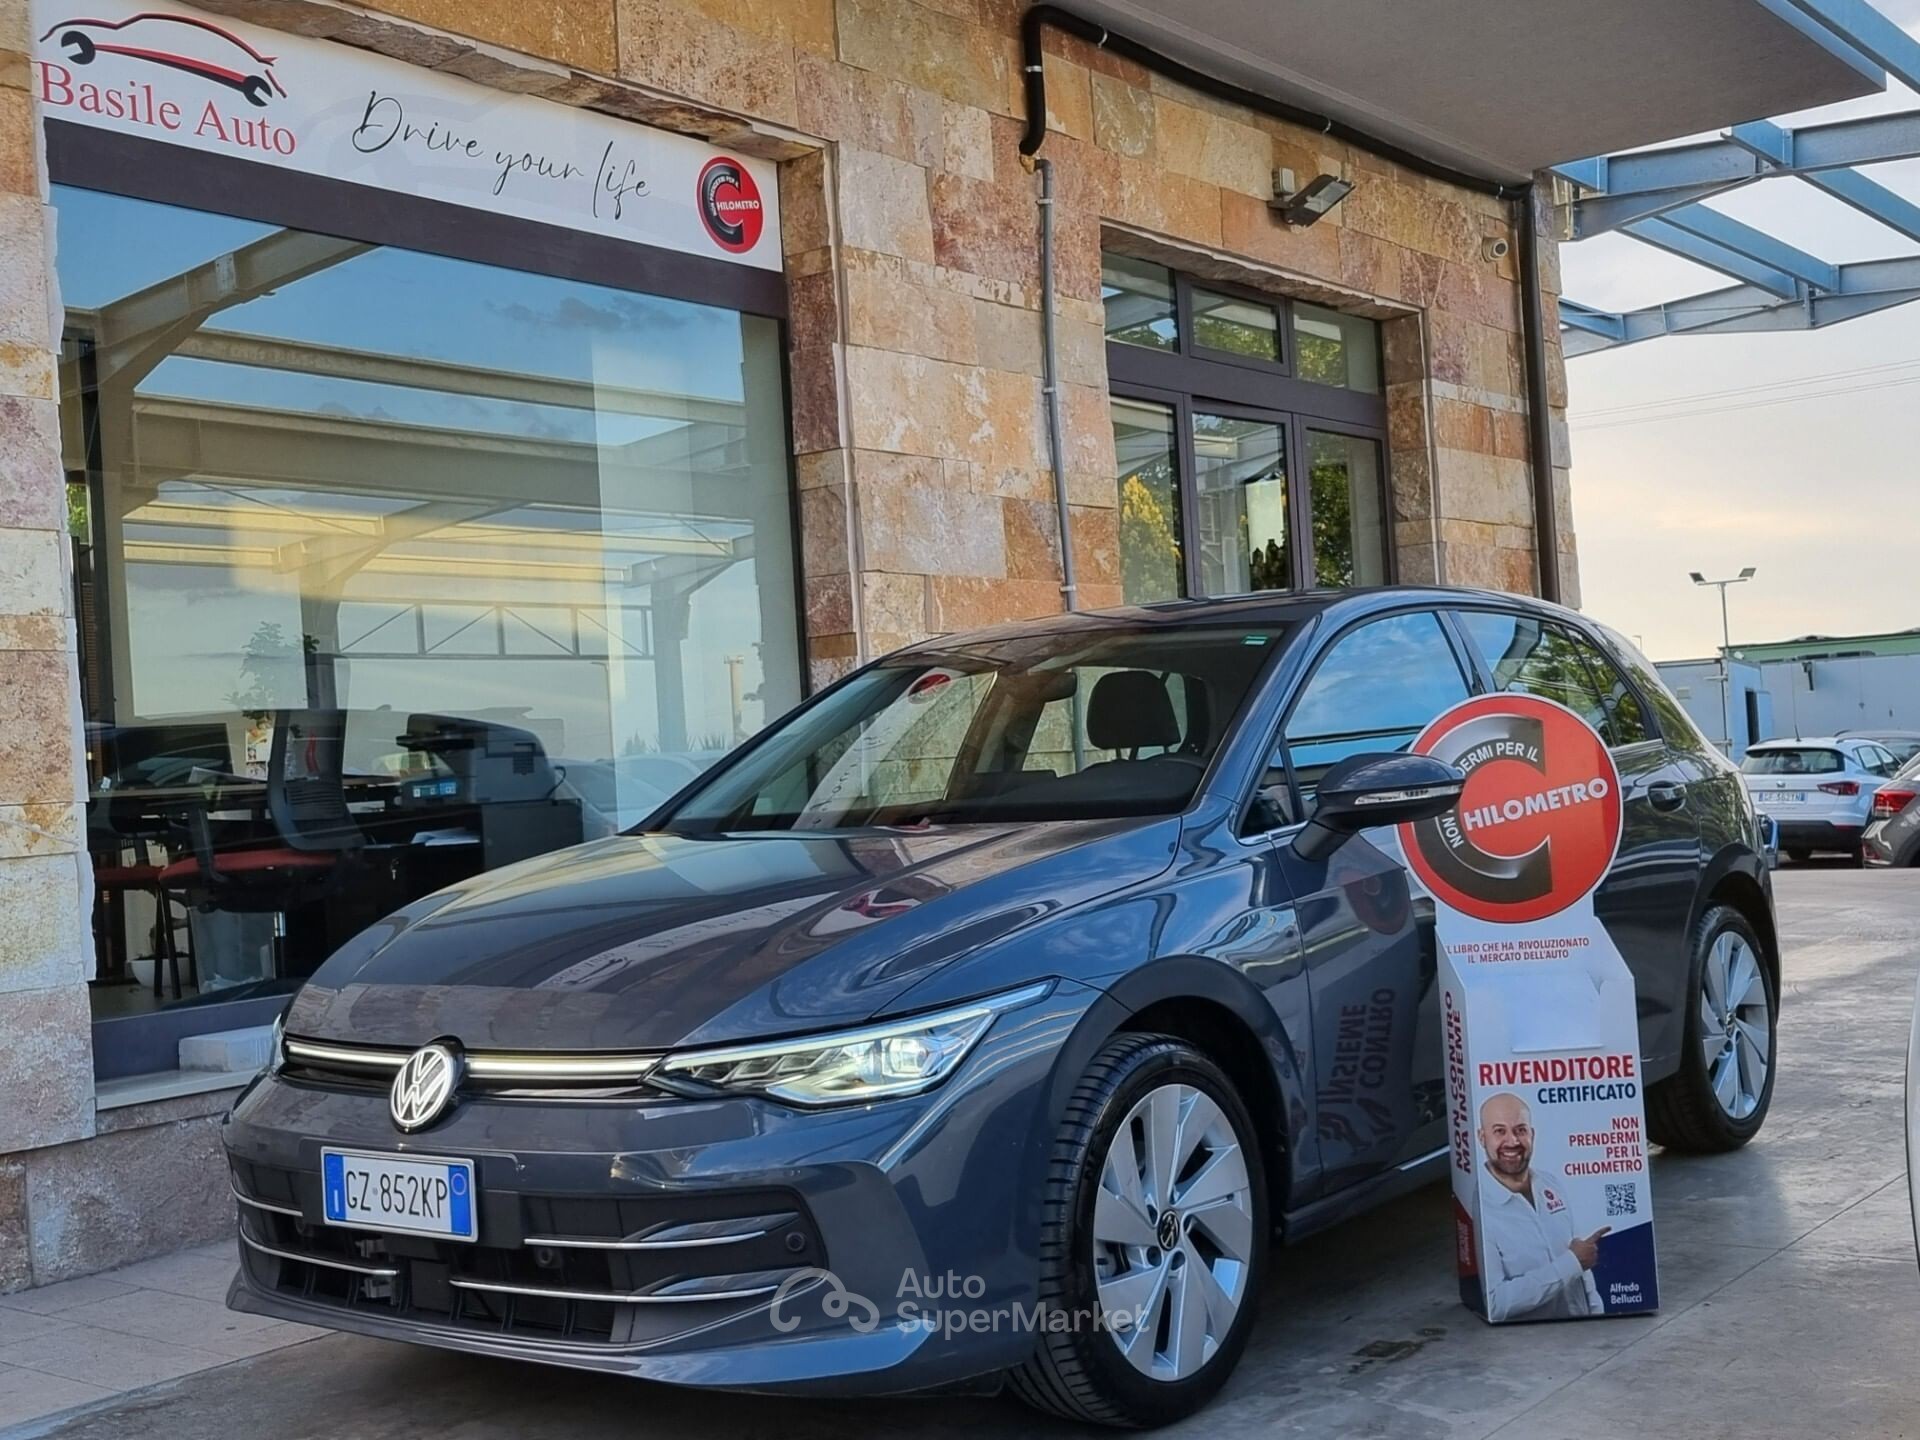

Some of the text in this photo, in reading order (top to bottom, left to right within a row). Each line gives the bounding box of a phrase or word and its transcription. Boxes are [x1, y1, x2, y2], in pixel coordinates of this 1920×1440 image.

[39, 61, 297, 155] Basile Auto
[352, 90, 651, 220] Drive your life
[1442, 816, 1465, 849] NON
[1496, 742, 1525, 757] PER
[1526, 746, 1539, 763] IL
[1453, 943, 1480, 954] LIBRO
[1482, 942, 1500, 952] CHE
[1501, 941, 1514, 951] HA
[1518, 937, 1590, 950] RIVOLUZIONATO
[1467, 949, 1569, 964] IL MERCATO DELL'AUTO
[1445, 991, 1464, 1169] NON CONTRO
[1478, 1055, 1635, 1087] RIVENDITORE
[1453, 1010, 1472, 1175] MA INSIEME
[1537, 1084, 1637, 1105] CERTIFICATO
[1611, 1117, 1639, 1130] NON
[1568, 1131, 1640, 1147] PRENDERMI
[1606, 1146, 1642, 1159] PER IL
[1564, 1160, 1643, 1176] CHILOMETRO
[345, 1170, 372, 1211] GZ
[379, 1173, 448, 1219] 852KP
[1609, 1282, 1640, 1294] Alfredo
[1610, 1293, 1642, 1305] Bellucci
